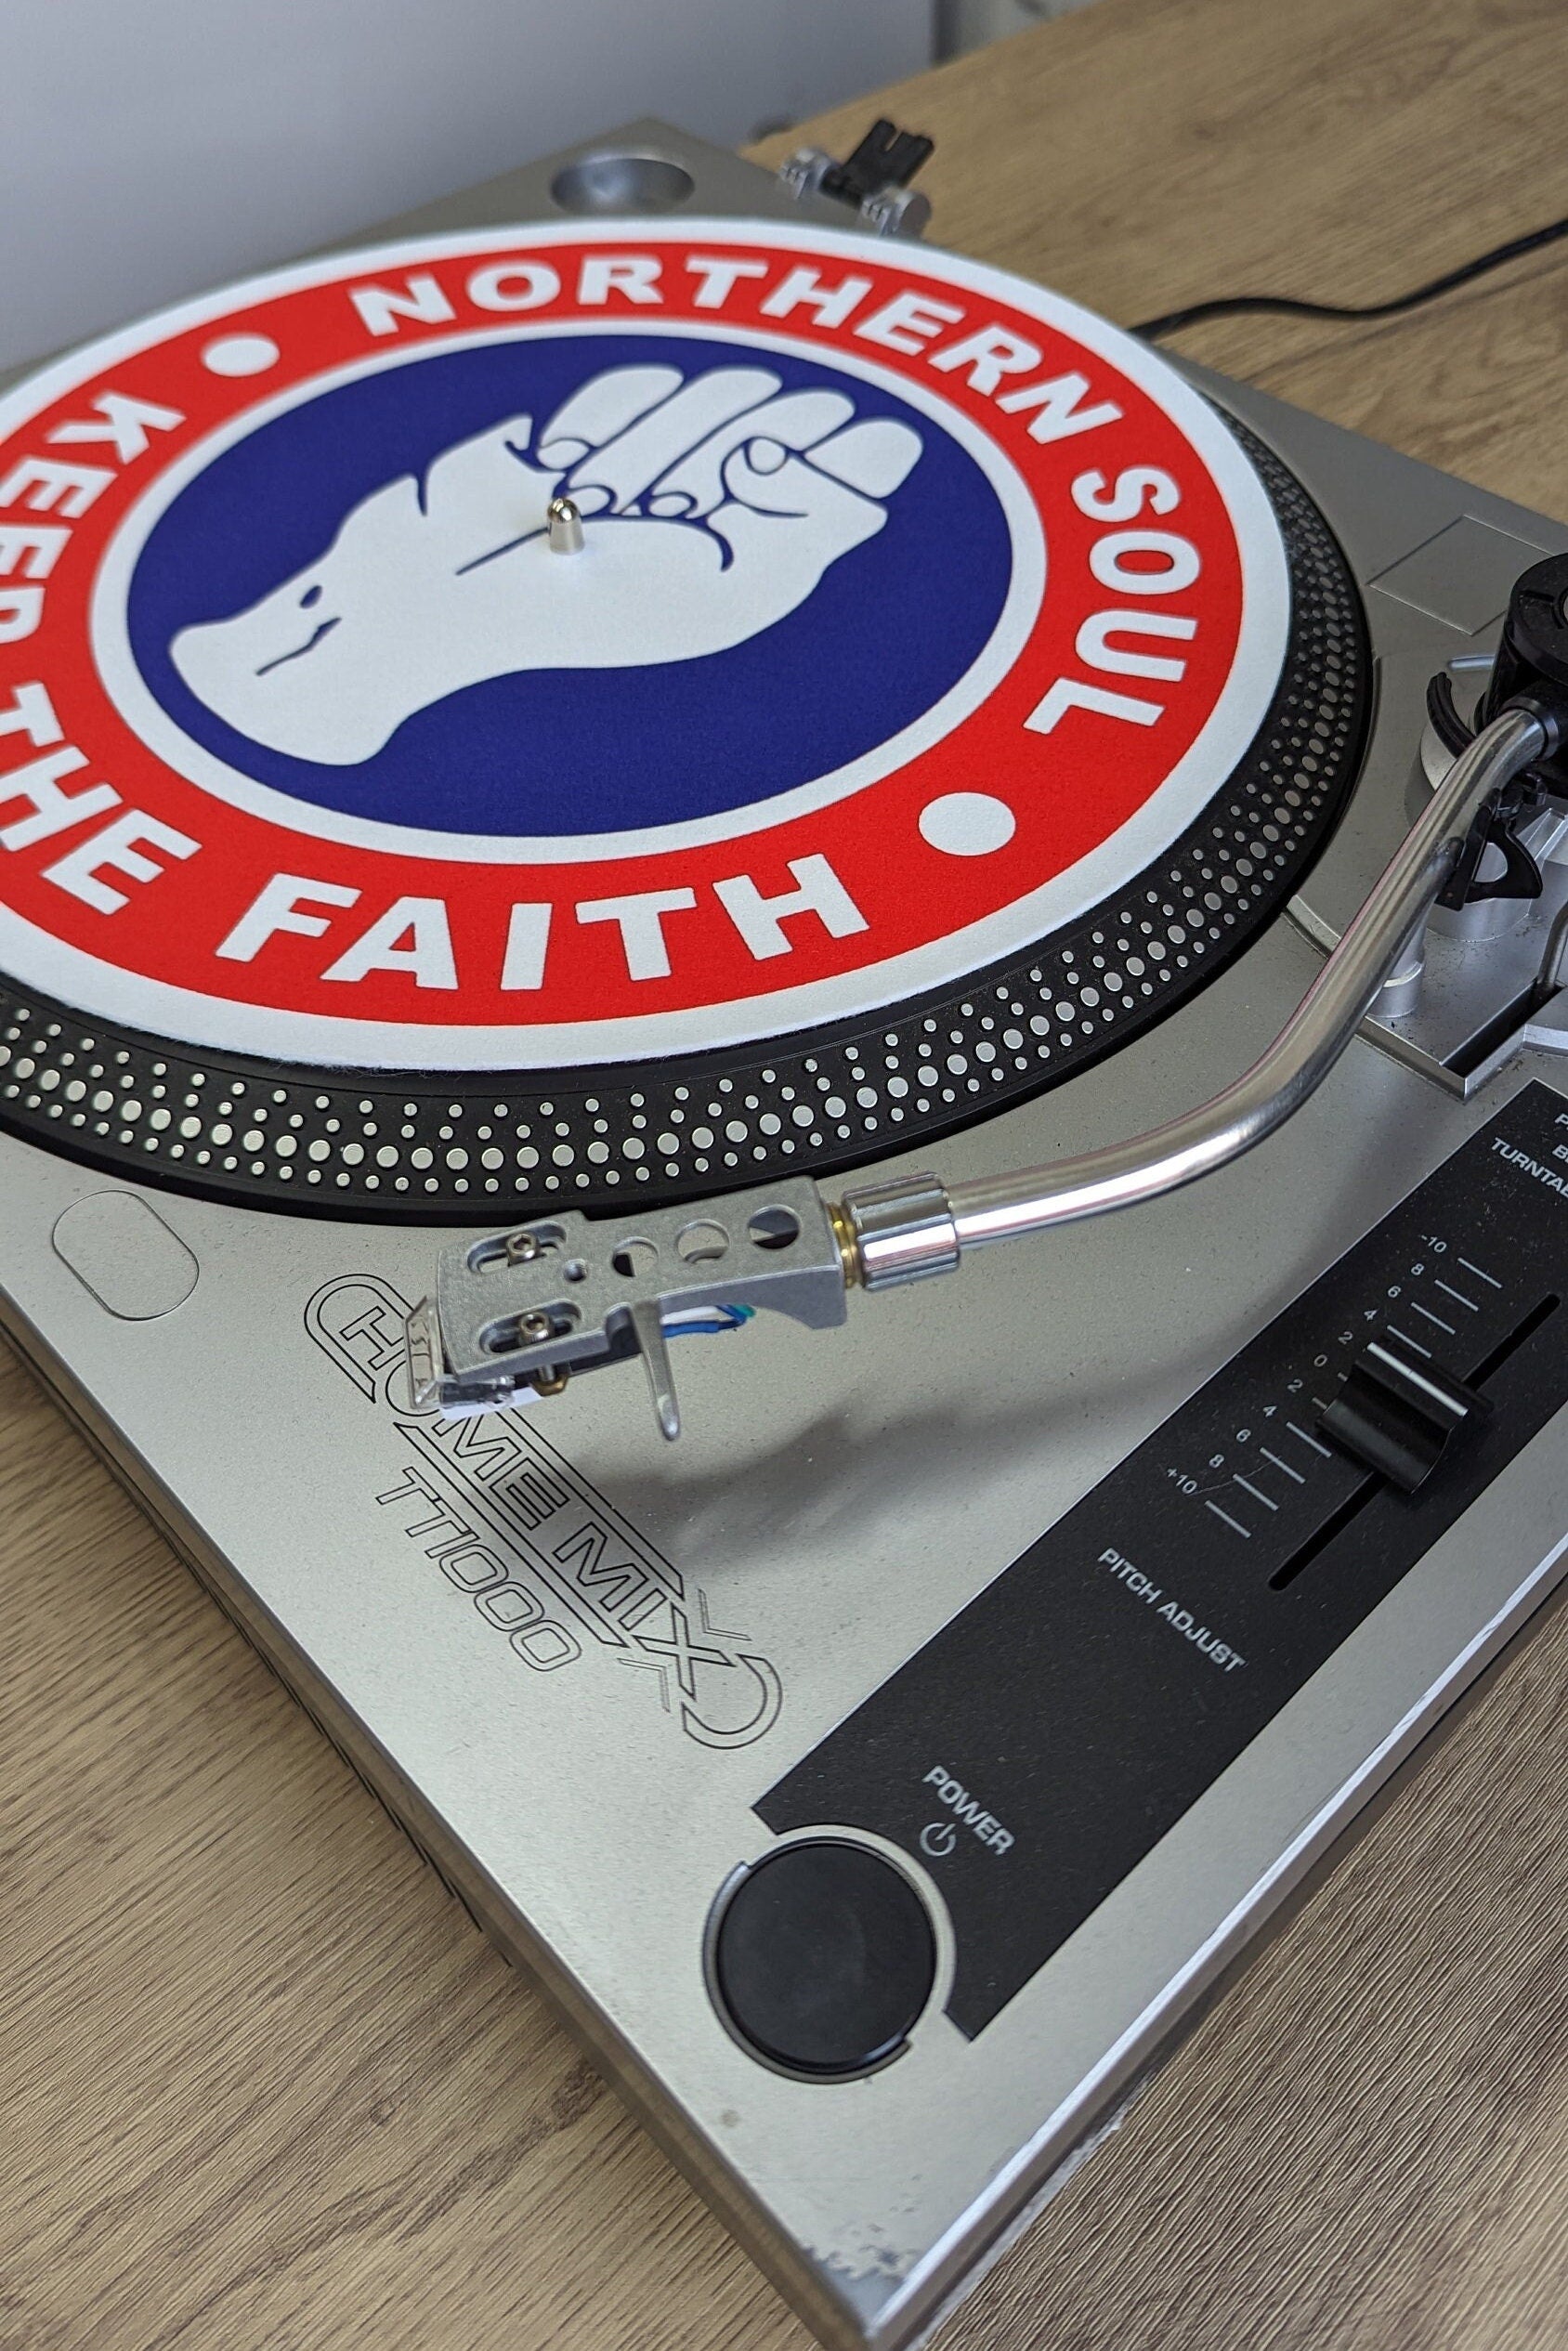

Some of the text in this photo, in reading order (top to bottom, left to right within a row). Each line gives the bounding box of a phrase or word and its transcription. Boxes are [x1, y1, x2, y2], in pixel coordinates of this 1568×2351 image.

[351, 254, 1200, 735] NORTHERN SOUL
[0, 390, 869, 994] KEEP THE FAITH
[1420, 1235, 1447, 1253] -10
[1410, 1262, 1425, 1275] 8
[1387, 1286, 1402, 1298] 6
[1364, 1308, 1379, 1321] 4
[1338, 1331, 1353, 1345] 2
[1313, 1353, 1328, 1367] 0
[1287, 1378, 1303, 1393] 2
[1262, 1404, 1277, 1417] 4
[1235, 1429, 1251, 1443] 6
[1209, 1454, 1225, 1469] 8
[1167, 1468, 1198, 1495] +10
[375, 1467, 582, 1673] TT1000
[553, 1522, 738, 1699] MIX
[1097, 1547, 1247, 1673] PITCH ADJUST
[921, 1765, 1015, 1856] POWER
